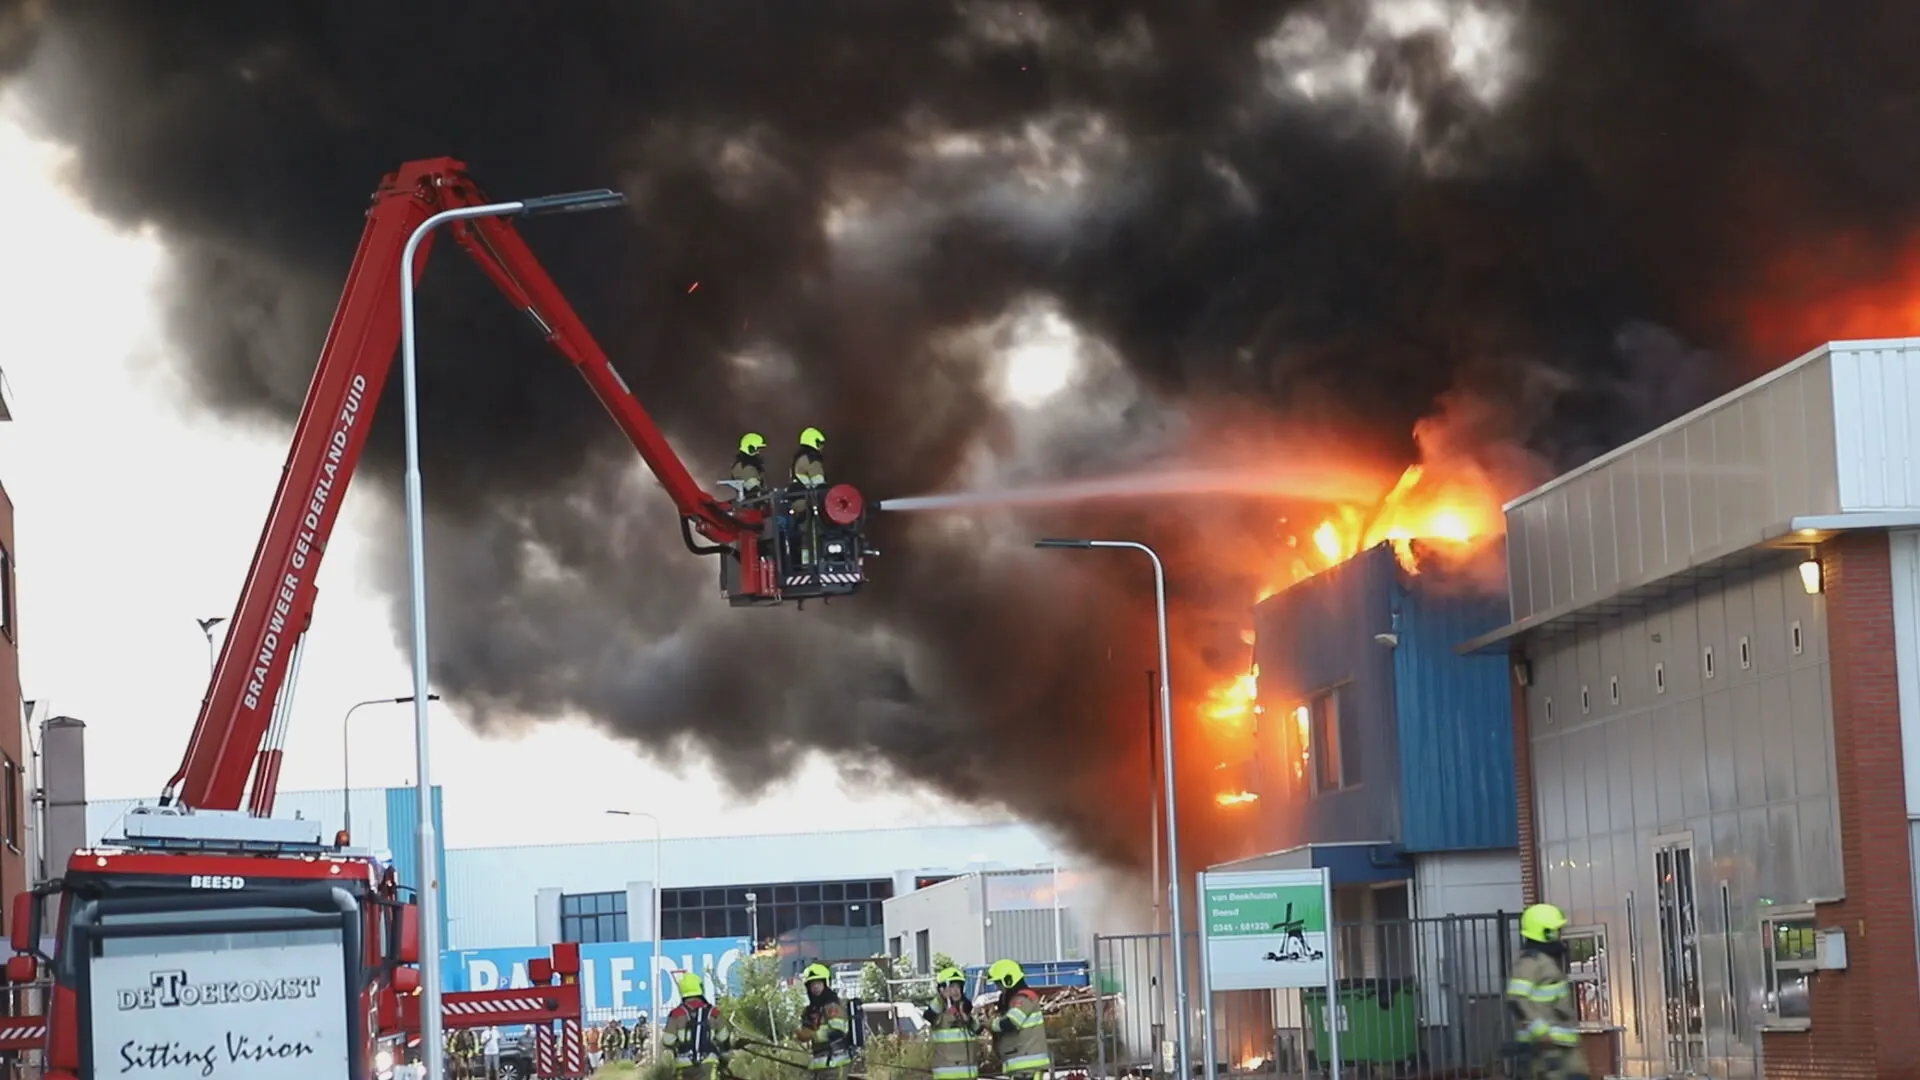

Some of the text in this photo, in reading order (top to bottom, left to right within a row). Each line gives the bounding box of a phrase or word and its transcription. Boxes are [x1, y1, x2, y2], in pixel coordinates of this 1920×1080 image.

[243, 374, 367, 711] BRANDWEER GELDERLAND-ZUID
[190, 875, 246, 890] BEESD
[120, 1030, 315, 1077] Sitting Vision
